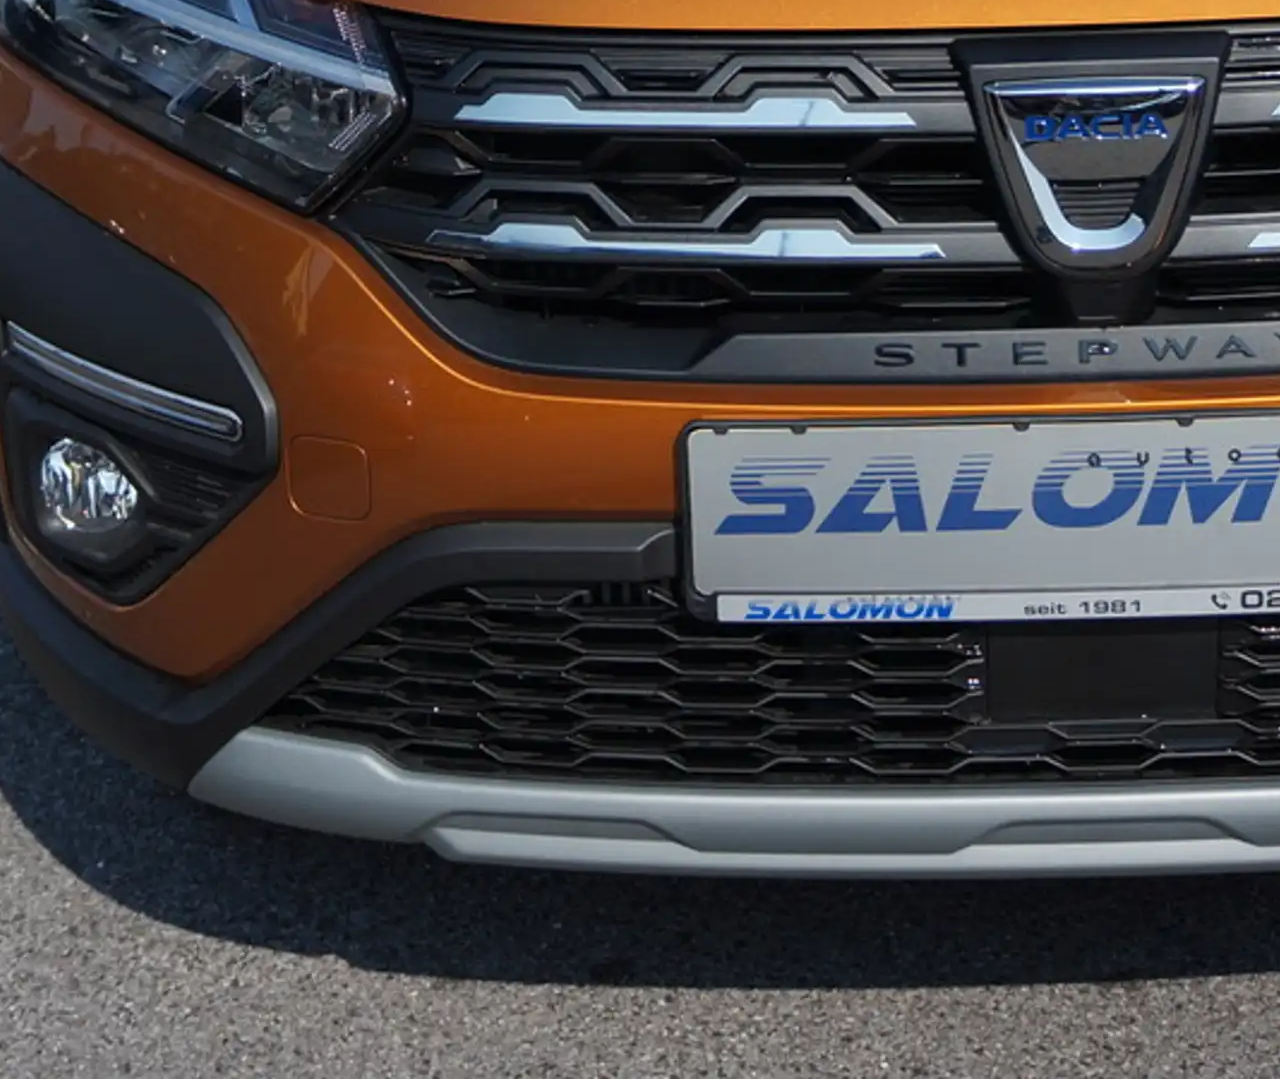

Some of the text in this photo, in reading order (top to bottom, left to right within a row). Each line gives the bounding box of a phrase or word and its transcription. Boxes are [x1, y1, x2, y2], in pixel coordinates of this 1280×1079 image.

[1023, 113, 1169, 144] DACIA
[744, 597, 958, 621] SALOMON
[1023, 603, 1067, 617] seit
[1078, 599, 1142, 615] 1981
